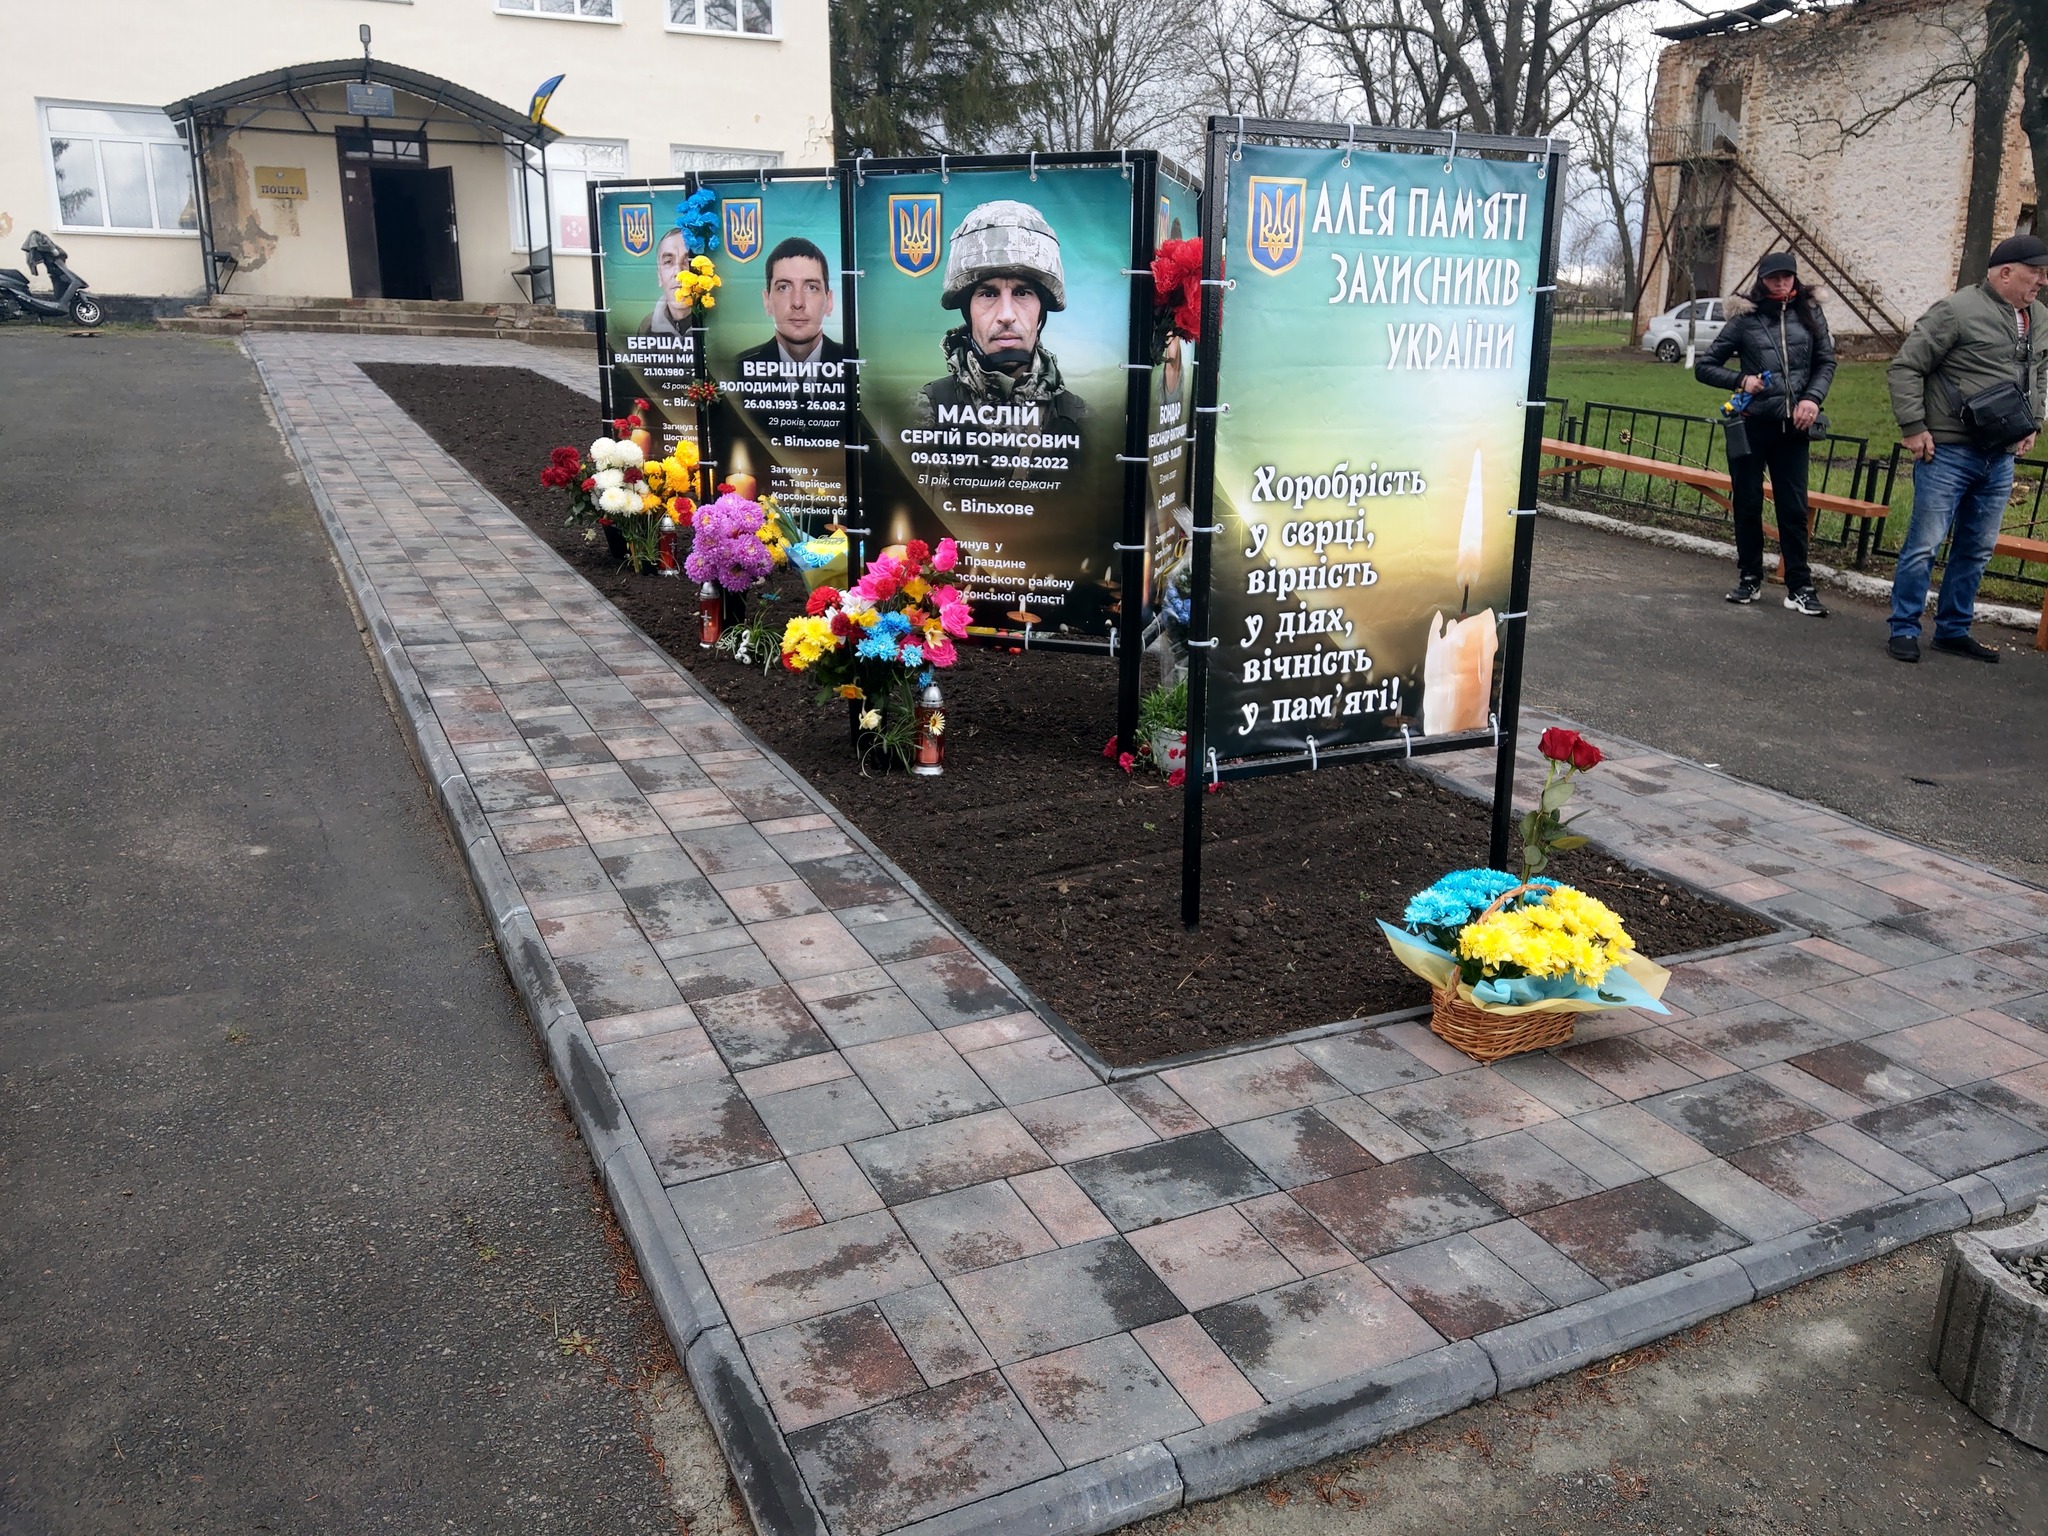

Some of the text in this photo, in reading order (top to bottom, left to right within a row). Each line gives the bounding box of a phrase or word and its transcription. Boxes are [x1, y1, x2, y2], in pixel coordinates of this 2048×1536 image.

[260, 185, 303, 195] ПОШТА
[1311, 181, 1528, 241] АЛЕЯ ПАМ’ЯТІ
[1328, 253, 1521, 306] ЗАХИСНИКІВ
[627, 336, 694, 352] БЕРШАД
[1386, 318, 1515, 370] УКРАЇНИ
[614, 353, 694, 364] ВАЛЕНТИН МИ
[643, 368, 685, 377] 21.10.1980
[743, 361, 845, 379] ВЕРШИГОР
[661, 382, 671, 390] 43
[719, 381, 845, 394] ВОЛОДИМИР ВІТАЛІ
[744, 399, 798, 410] 26.08.1993
[806, 400, 846, 411] 26.08.2
[938, 401, 1040, 426] МАСЛІЙ
[662, 423, 693, 432] Загинув
[768, 417, 840, 428] 29 років, солдат
[663, 433, 699, 442] Шосткин
[770, 435, 840, 448] с. Вільхове
[900, 428, 1080, 449] СЕРГІЙ БОРИСОВИЧ
[911, 451, 979, 467] 09.03.1971
[990, 454, 1069, 470] 29.08.2022
[770, 465, 818, 476] Загинув у
[771, 479, 841, 489] н.п. Таврійське
[917, 474, 1061, 491] 51 рік, старший сержант
[1251, 461, 1427, 509] Хоробрість
[943, 499, 1035, 515] с. Вільхове
[1245, 508, 1375, 558] у серці,
[941, 538, 1003, 553] гинув у
[964, 555, 1026, 569] Правдине
[955, 573, 1075, 591] рсонського району
[1246, 555, 1378, 601] вірність
[956, 589, 1065, 605] рсонської області
[1240, 600, 1353, 648] у діях,
[1242, 643, 1373, 684] вічність
[1238, 676, 1400, 736] у пам’яті!
